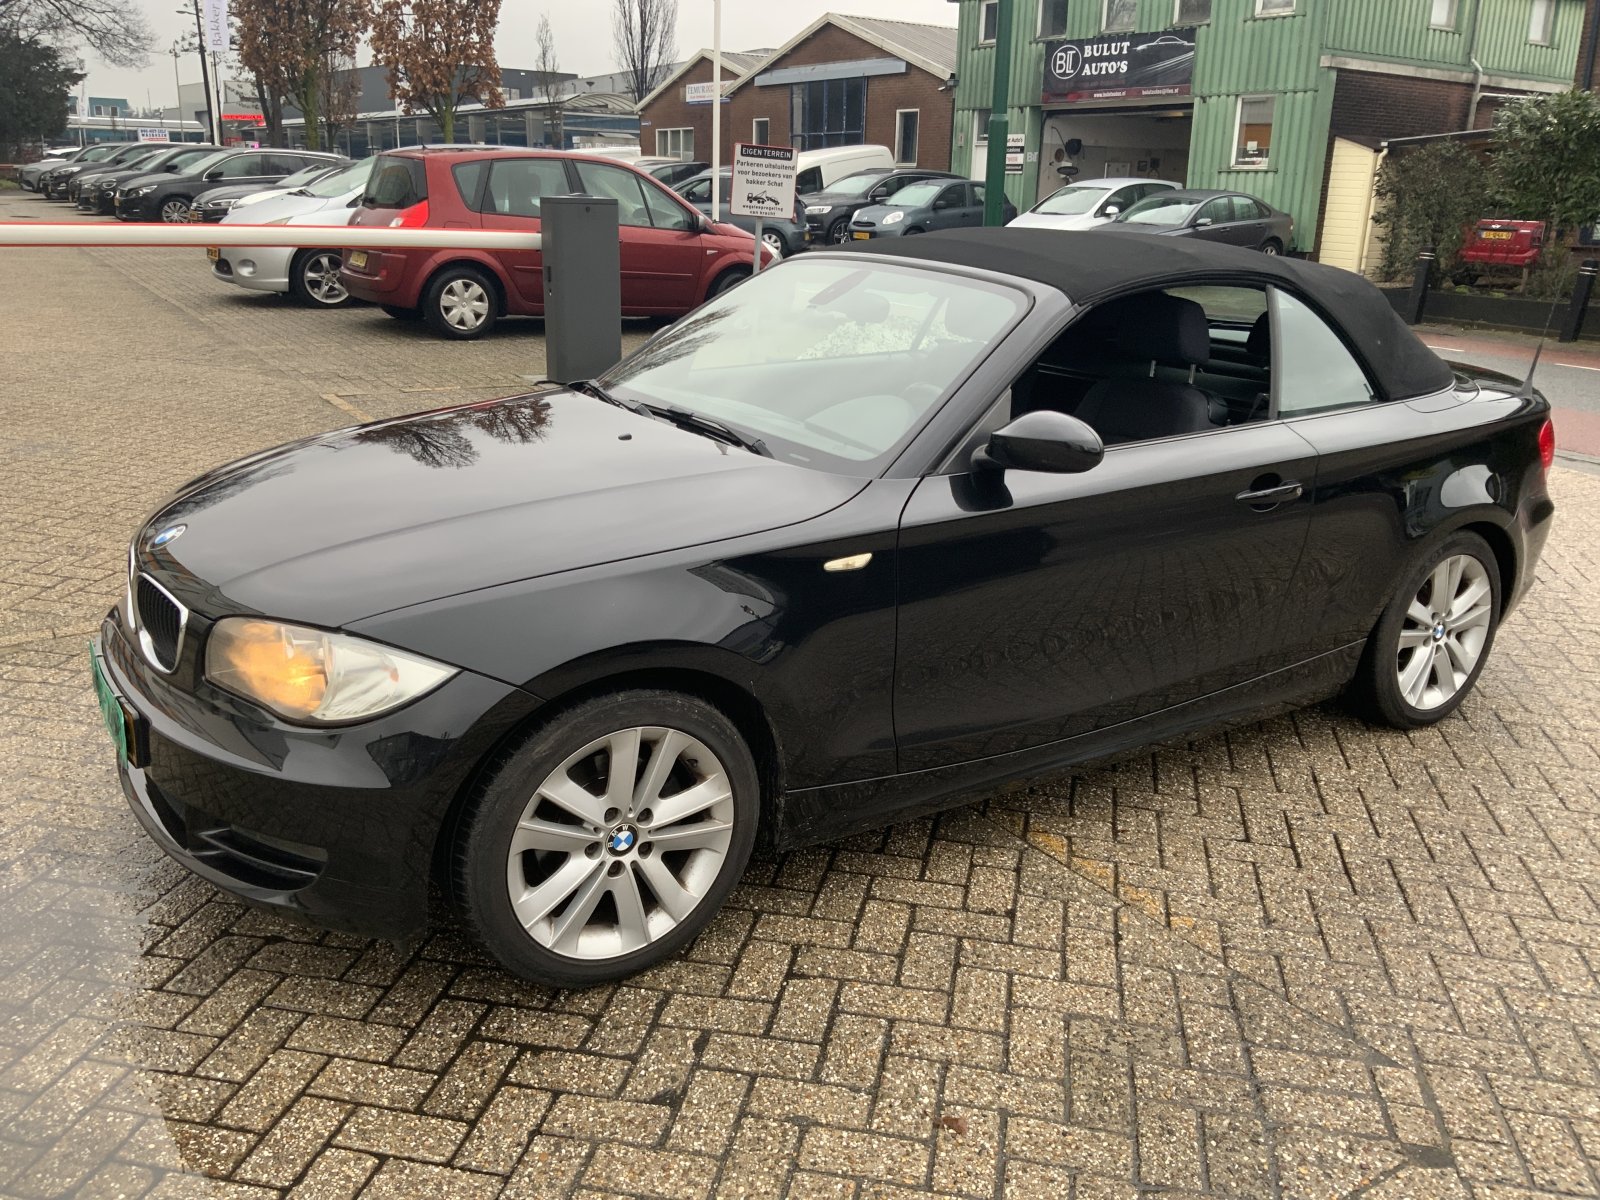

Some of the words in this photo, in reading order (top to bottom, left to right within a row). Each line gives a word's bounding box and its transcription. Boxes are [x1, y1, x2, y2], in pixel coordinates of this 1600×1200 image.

[1083, 41, 1131, 58] BULUT
[1081, 60, 1129, 76] AUTO'S
[742, 147, 762, 156] EIGEN
[763, 149, 792, 159] TERREIN
[736, 159, 764, 168] Parkeren
[764, 163, 796, 171] uitsluitend
[751, 170, 782, 179] bezoekers
[745, 178, 766, 186] bakker
